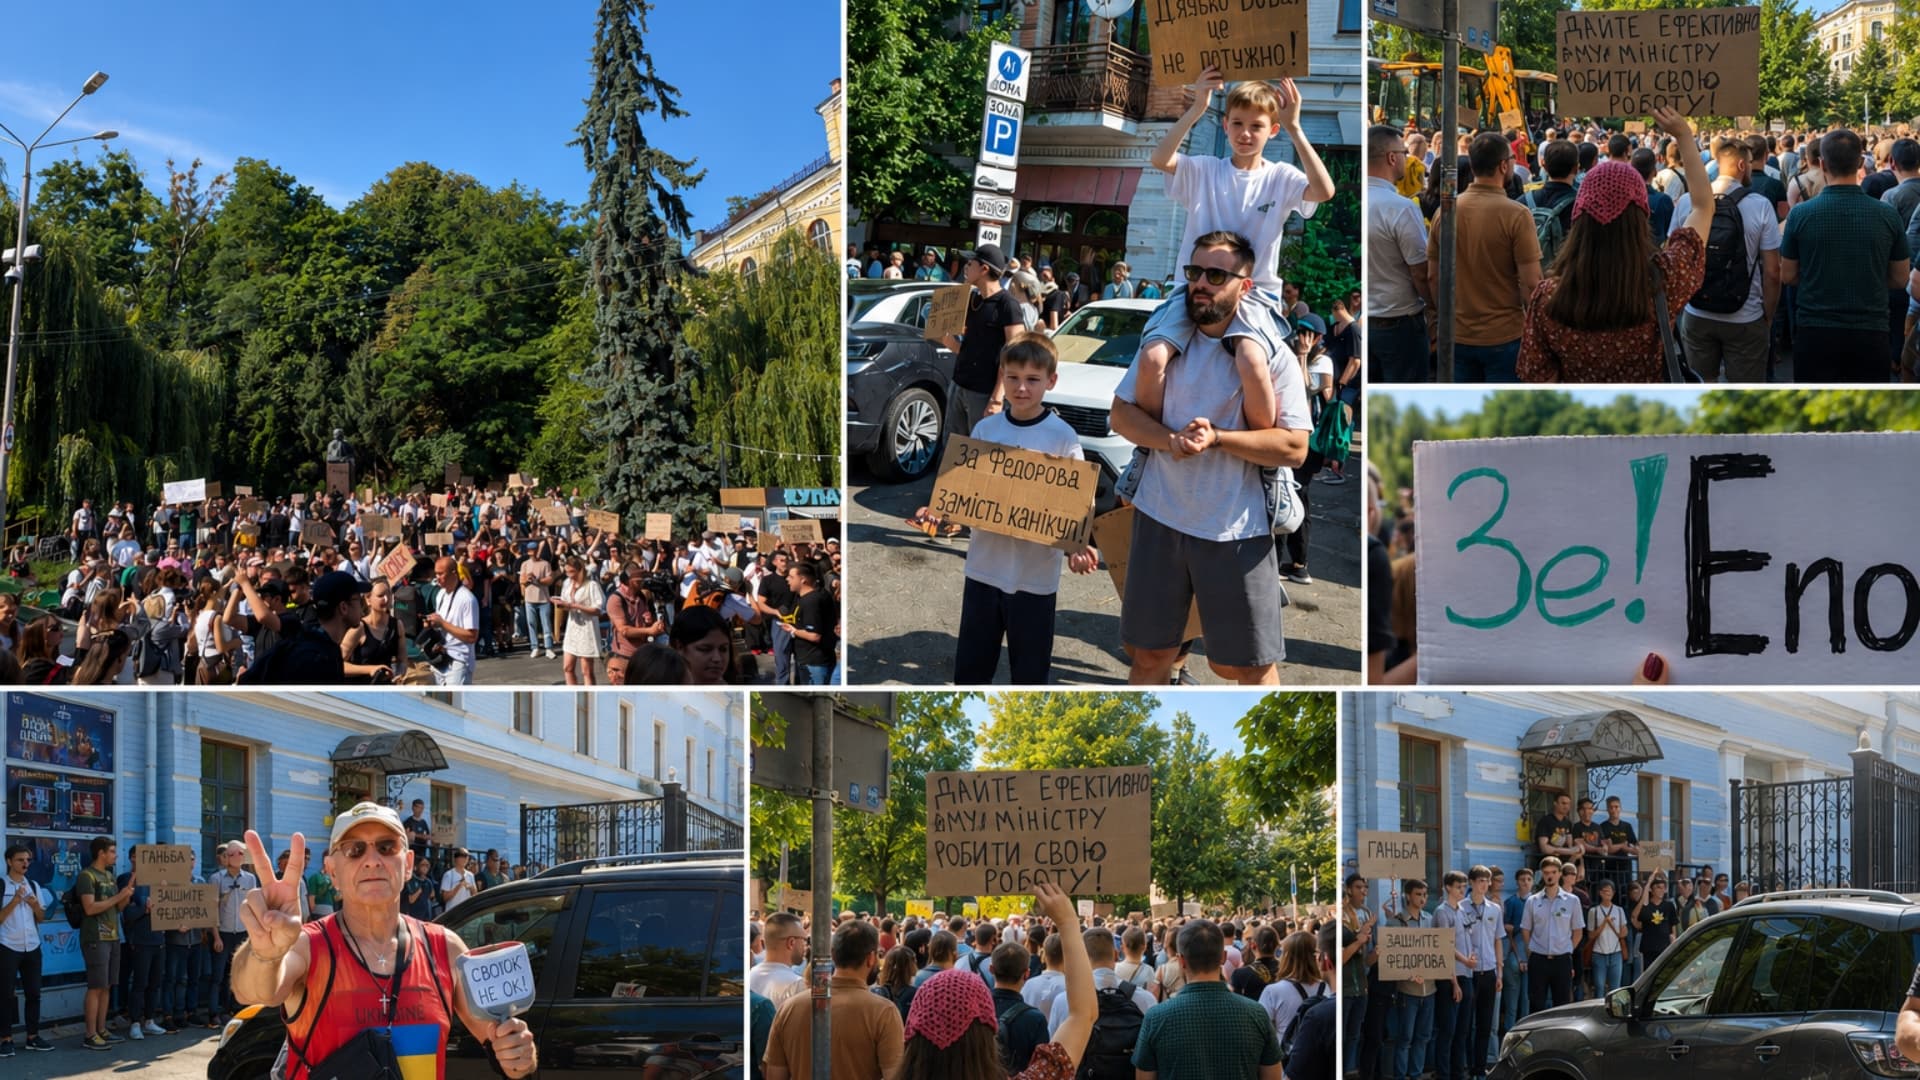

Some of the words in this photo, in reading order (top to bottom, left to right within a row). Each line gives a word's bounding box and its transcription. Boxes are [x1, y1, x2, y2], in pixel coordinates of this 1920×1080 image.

[1563, 14, 1640, 44] ДАЙТЕ
[1659, 12, 1760, 39] ЕФЕКТИВНО
[1564, 68, 1641, 94] РОБИТИ
[1655, 69, 1720, 93] СВОЮ
[954, 443, 979, 471] За
[934, 775, 1018, 809] ДАЙТЕ
[1039, 773, 1149, 801] ЕФЕКТИВНО
[142, 850, 186, 865] ГАНЬБА
[934, 840, 1020, 868] РОБИТИ
[1034, 836, 1106, 866] СВОЮ
[1368, 840, 1419, 860] ГАНЬБА
[1386, 953, 1447, 970] ФЕДОРОВА
[478, 985, 498, 1005] НЕ
